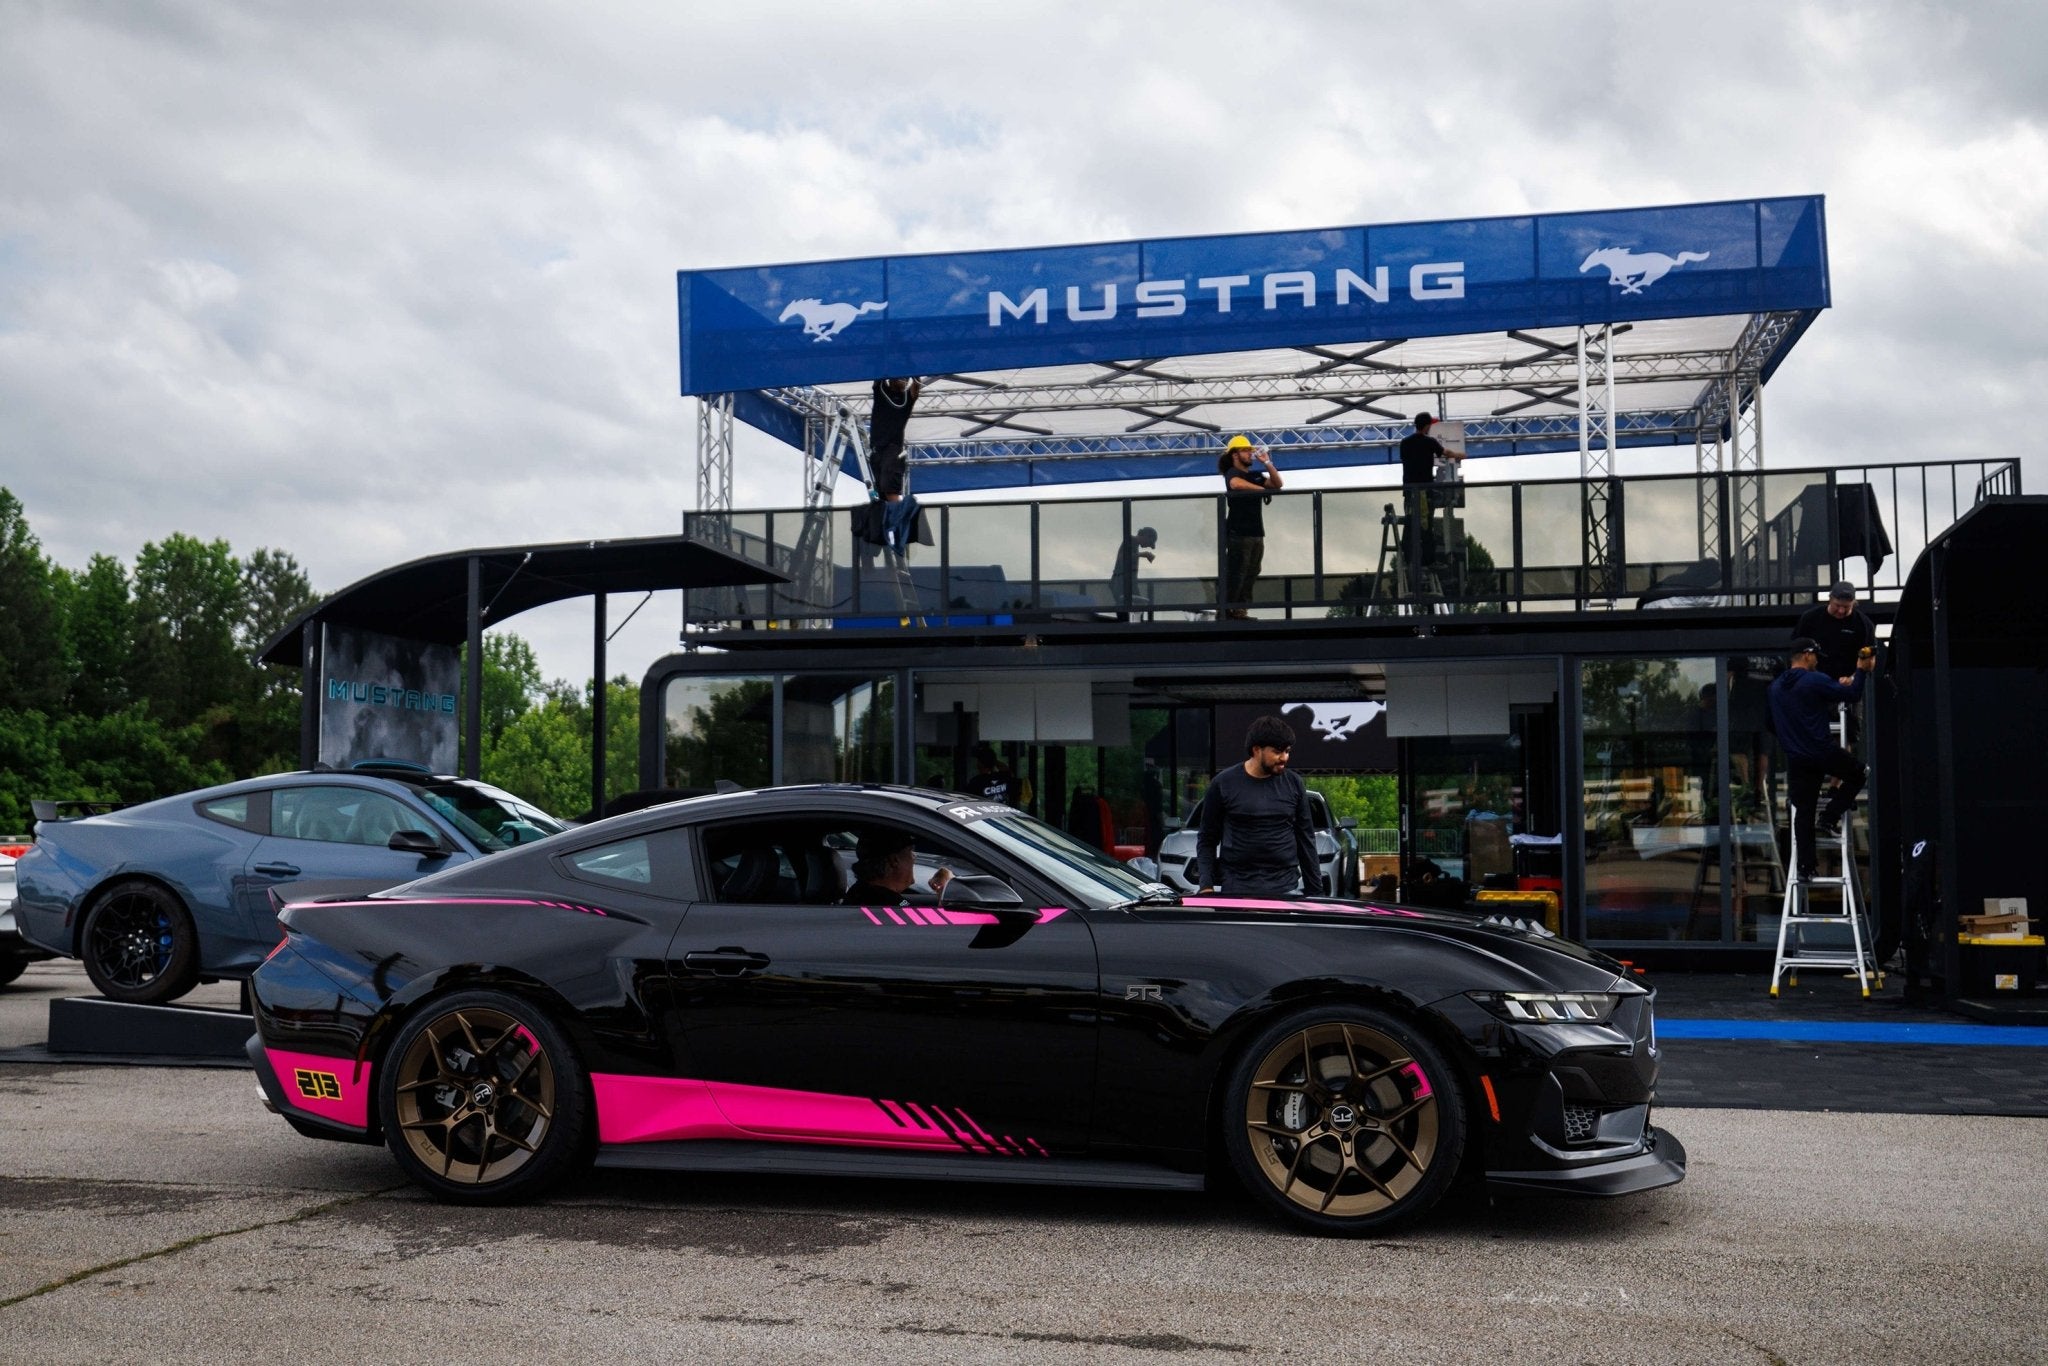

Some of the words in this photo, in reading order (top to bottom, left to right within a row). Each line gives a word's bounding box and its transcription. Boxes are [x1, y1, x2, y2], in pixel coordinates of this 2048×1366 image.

[988, 261, 1465, 327] MUSTANG
[328, 678, 456, 714] MUSTANG
[984, 783, 1007, 795] CREW
[1124, 984, 1164, 1001] RTR
[294, 1068, 343, 1101] 213
